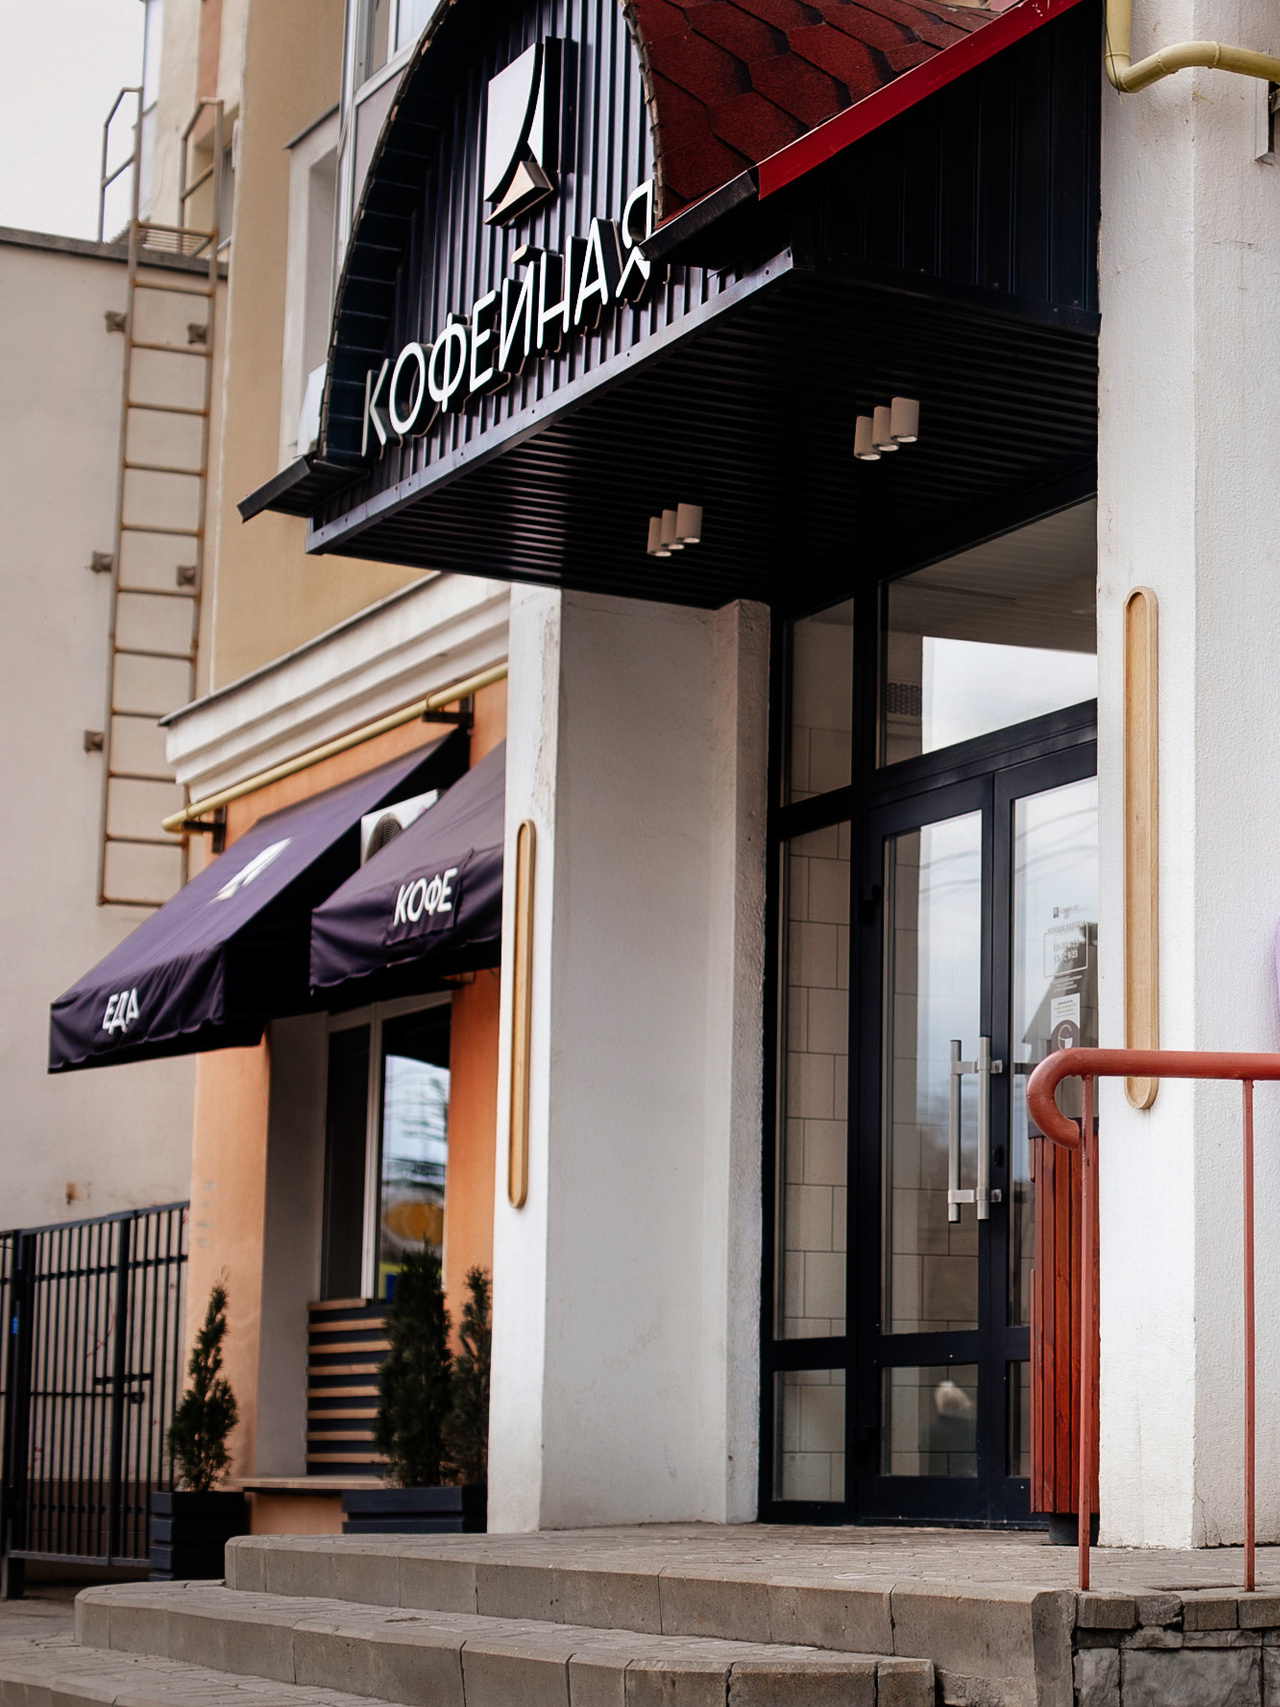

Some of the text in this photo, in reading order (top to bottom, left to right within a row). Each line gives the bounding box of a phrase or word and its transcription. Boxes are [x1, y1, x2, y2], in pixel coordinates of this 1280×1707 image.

[361, 178, 654, 458] КОФЕЙНАЯ
[393, 867, 458, 927] КОФЕ
[102, 986, 140, 1036] ЕДА
